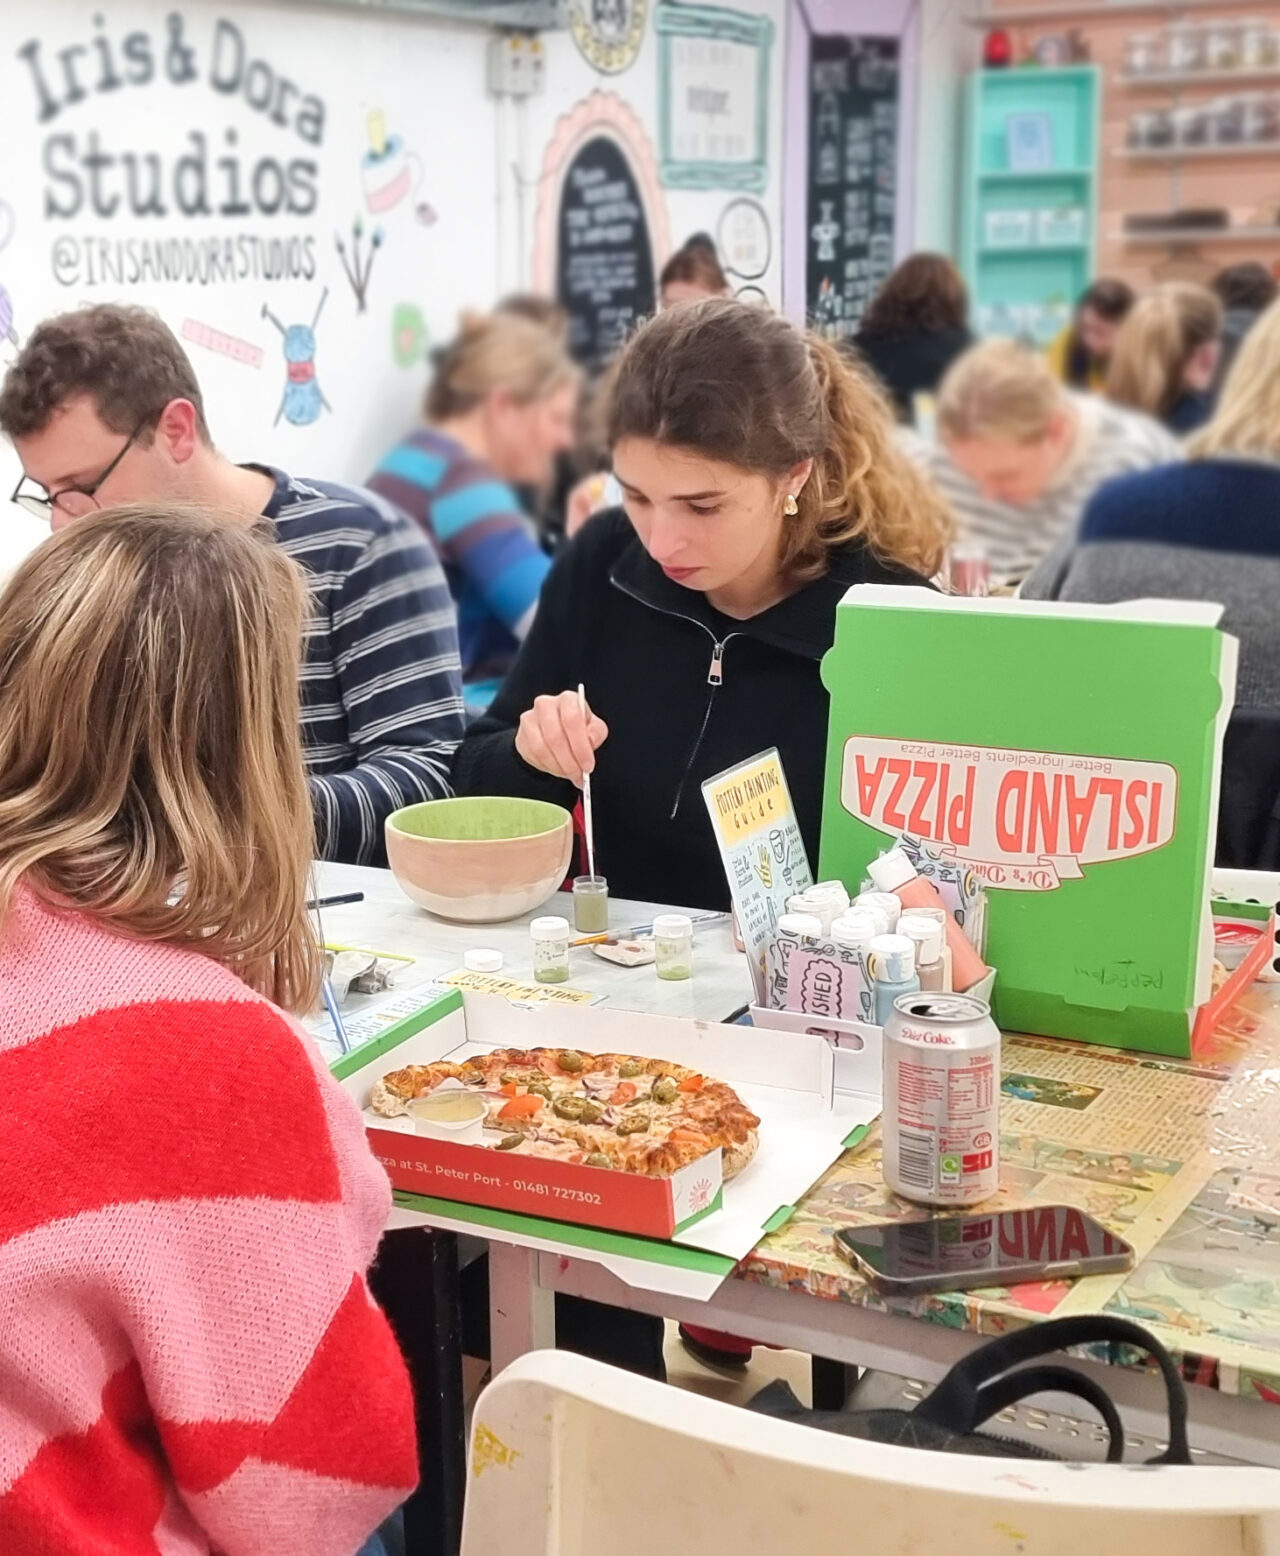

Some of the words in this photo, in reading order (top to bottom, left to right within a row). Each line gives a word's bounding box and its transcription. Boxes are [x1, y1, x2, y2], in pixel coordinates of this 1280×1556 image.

[18, 15, 155, 123] Iris
[165, 12, 199, 85] &
[210, 19, 328, 147] Dora
[43, 129, 320, 221] Studios
[51, 235, 316, 286] @IRISANDDORASTUDIOS
[900, 743, 937, 759] Pizza
[940, 747, 982, 762] Better
[986, 751, 1066, 770] ingredients
[1069, 758, 1113, 774] Better
[855, 754, 976, 847] PIZZA
[995, 769, 1163, 855] ISLAND
[923, 1031, 952, 1045] Coke
[399, 1160, 413, 1170] at
[415, 1162, 433, 1174] St.
[435, 1164, 471, 1181] Peter
[473, 1172, 502, 1187] Port
[513, 1180, 550, 1196] 01481
[552, 1186, 602, 1206] 727302
